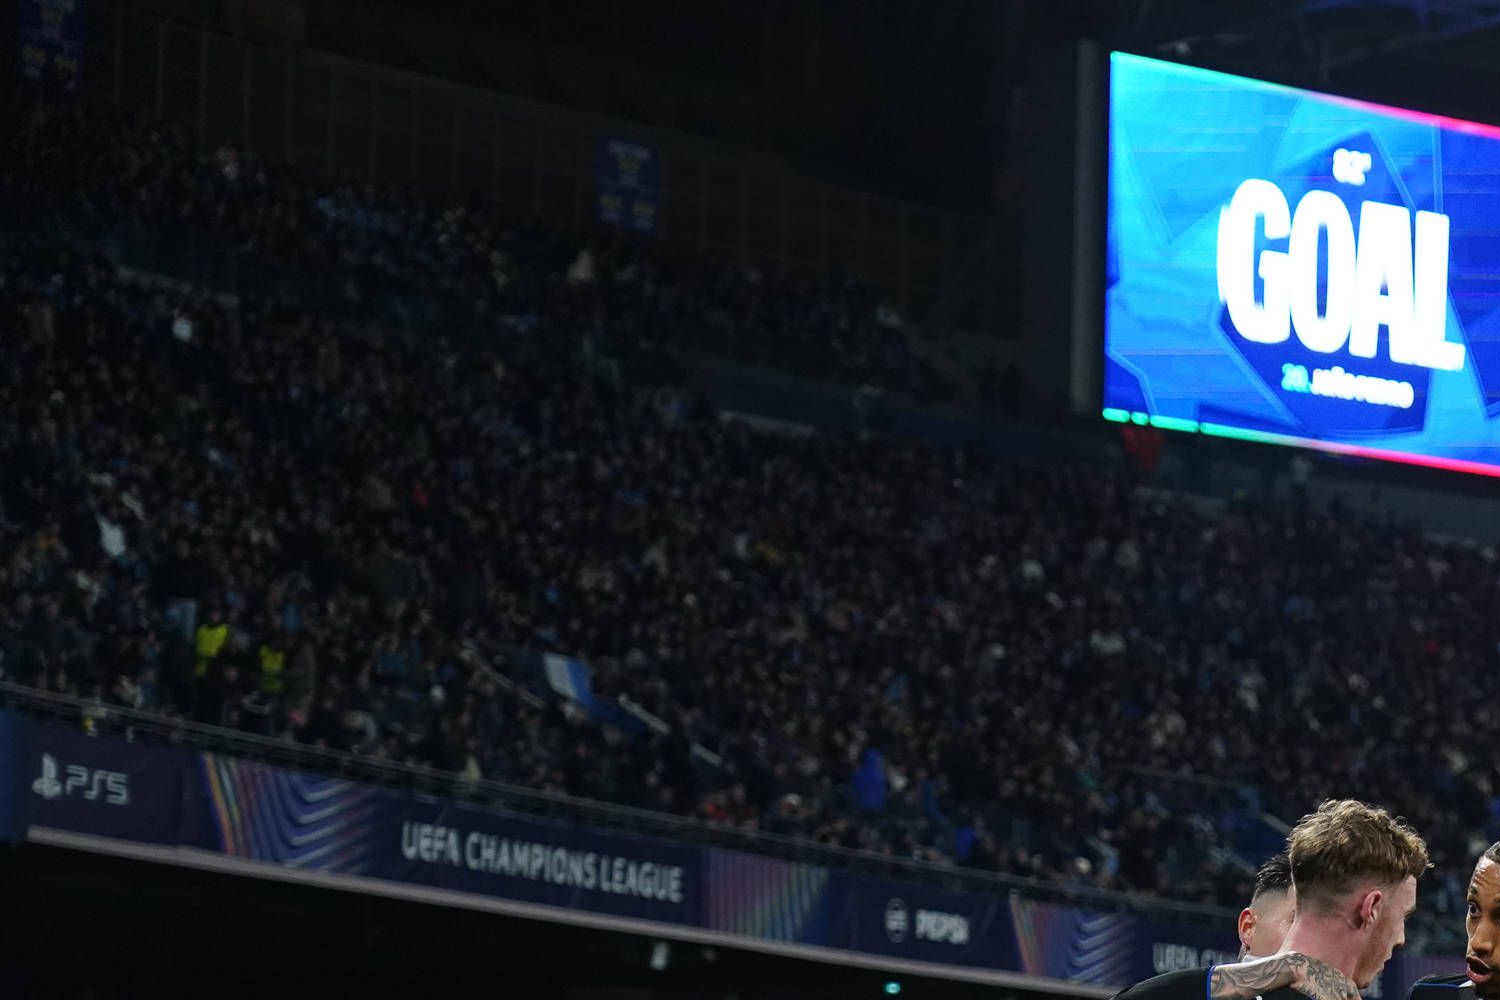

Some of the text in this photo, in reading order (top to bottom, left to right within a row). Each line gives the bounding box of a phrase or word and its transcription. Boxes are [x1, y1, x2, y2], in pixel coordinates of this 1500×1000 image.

[1216, 178, 1466, 372] GOAL
[65, 764, 129, 806] PS5
[402, 821, 684, 904] UEFA CHAMPIONS LEAGUE
